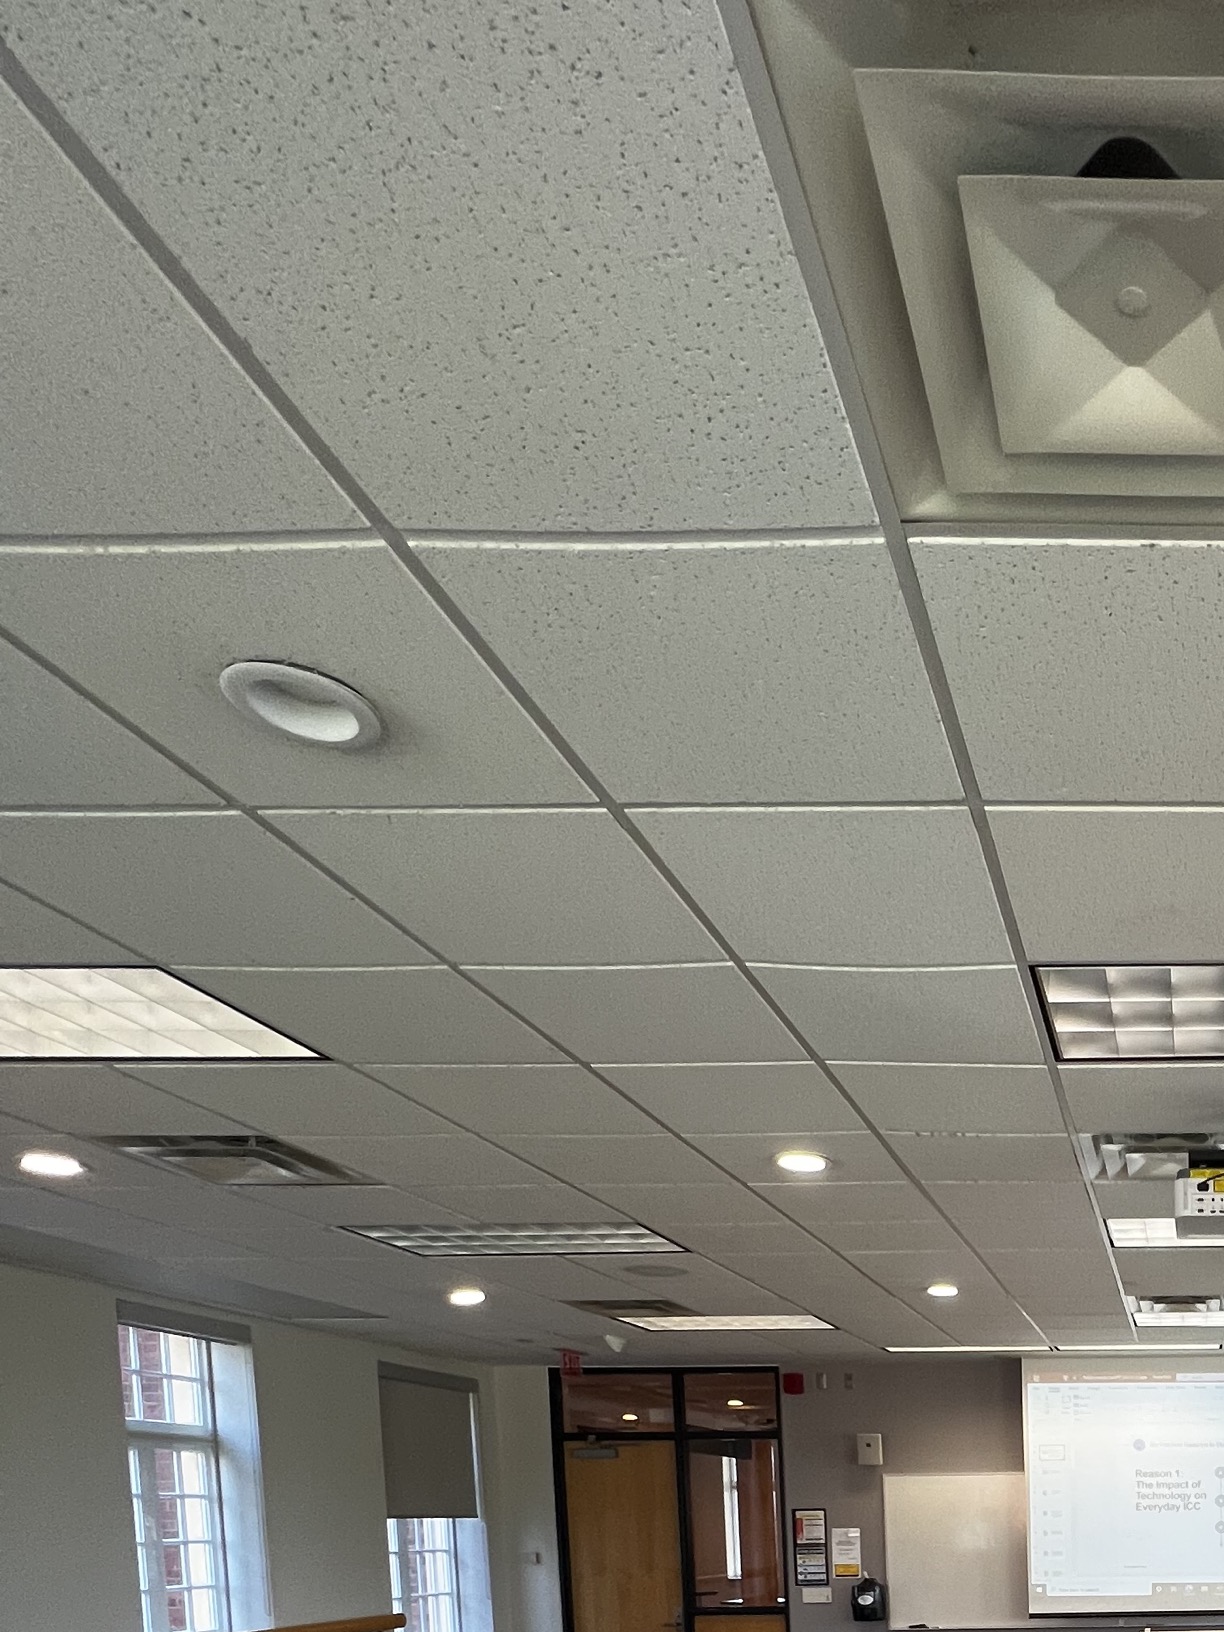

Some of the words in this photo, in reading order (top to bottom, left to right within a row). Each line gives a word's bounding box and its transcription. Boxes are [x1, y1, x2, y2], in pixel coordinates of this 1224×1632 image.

[1135, 1469, 1172, 1478] Reason
[1135, 1480, 1154, 1489] The
[1156, 1480, 1189, 1490] Impact
[1191, 1480, 1201, 1489] of
[1135, 1491, 1191, 1502] Technology
[1194, 1492, 1207, 1500] on
[1135, 1502, 1180, 1513] Everyday
[1183, 1501, 1201, 1511] ICC
